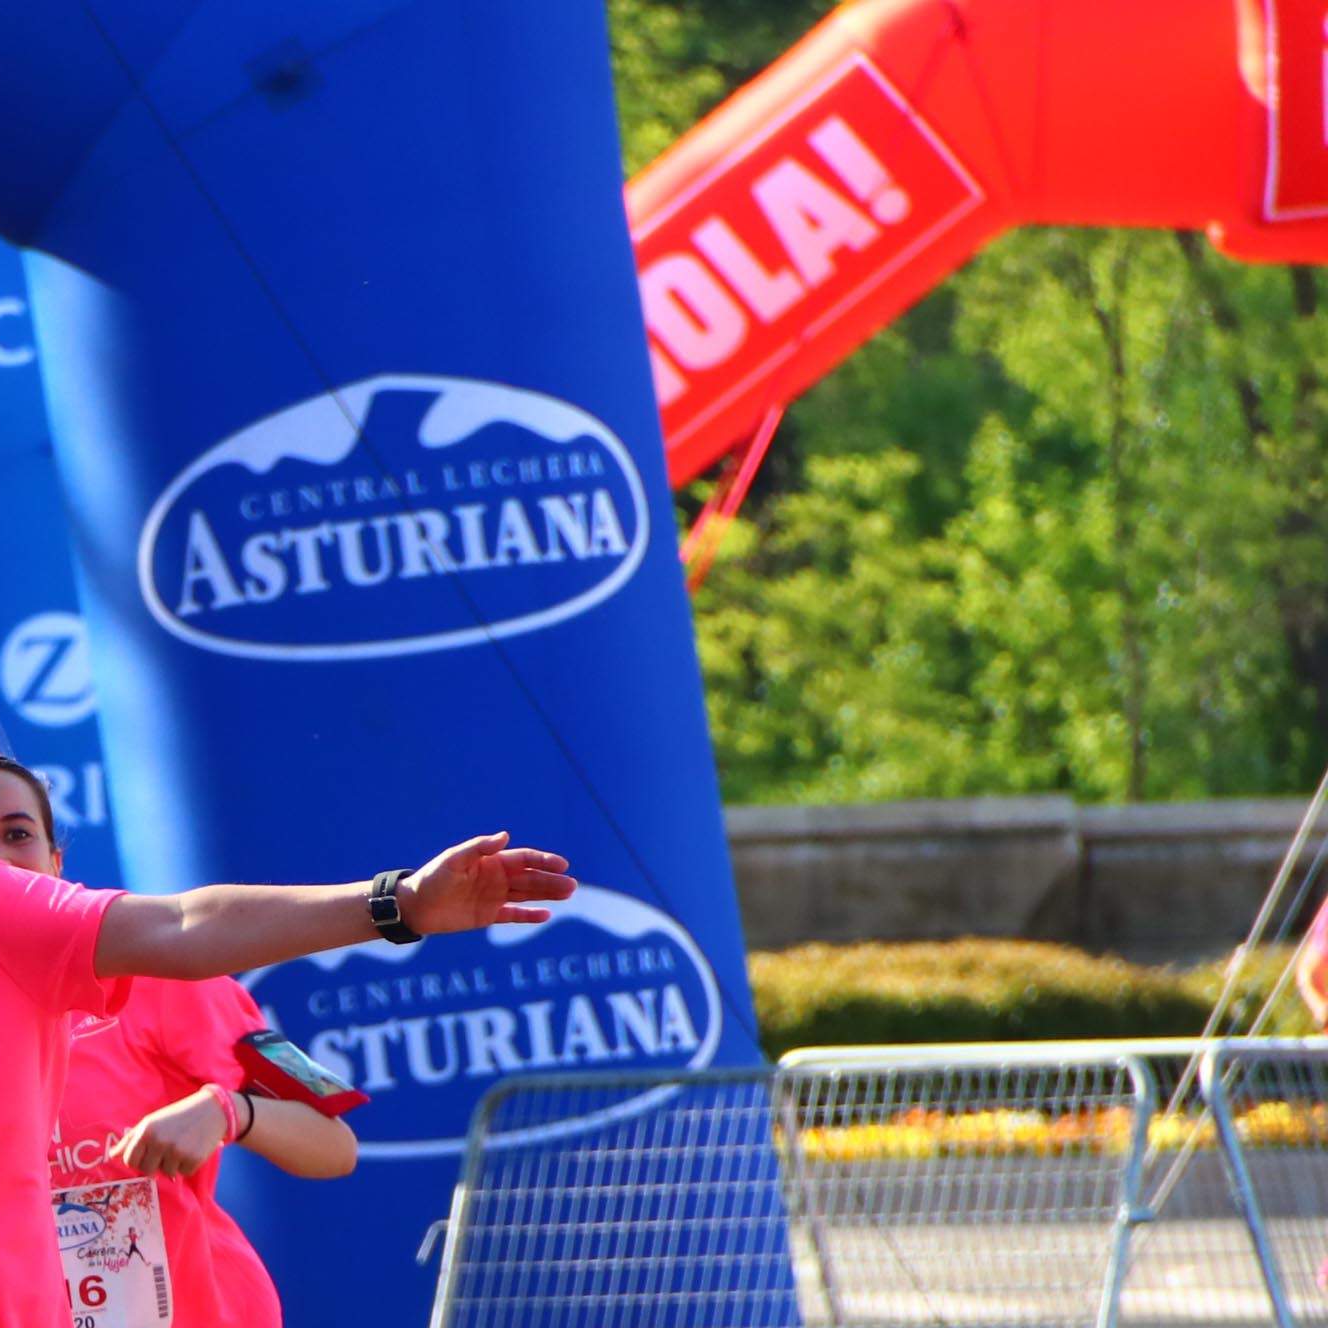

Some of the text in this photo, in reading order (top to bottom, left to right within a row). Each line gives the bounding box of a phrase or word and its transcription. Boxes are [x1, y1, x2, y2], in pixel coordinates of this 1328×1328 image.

[640, 114, 912, 407] OLA!
[240, 450, 606, 521] CENTRAL LECHERA
[176, 489, 629, 616] ASTURIANA
[309, 946, 676, 1018] CENTRAL LECHERA
[265, 983, 701, 1090] STURIANA
